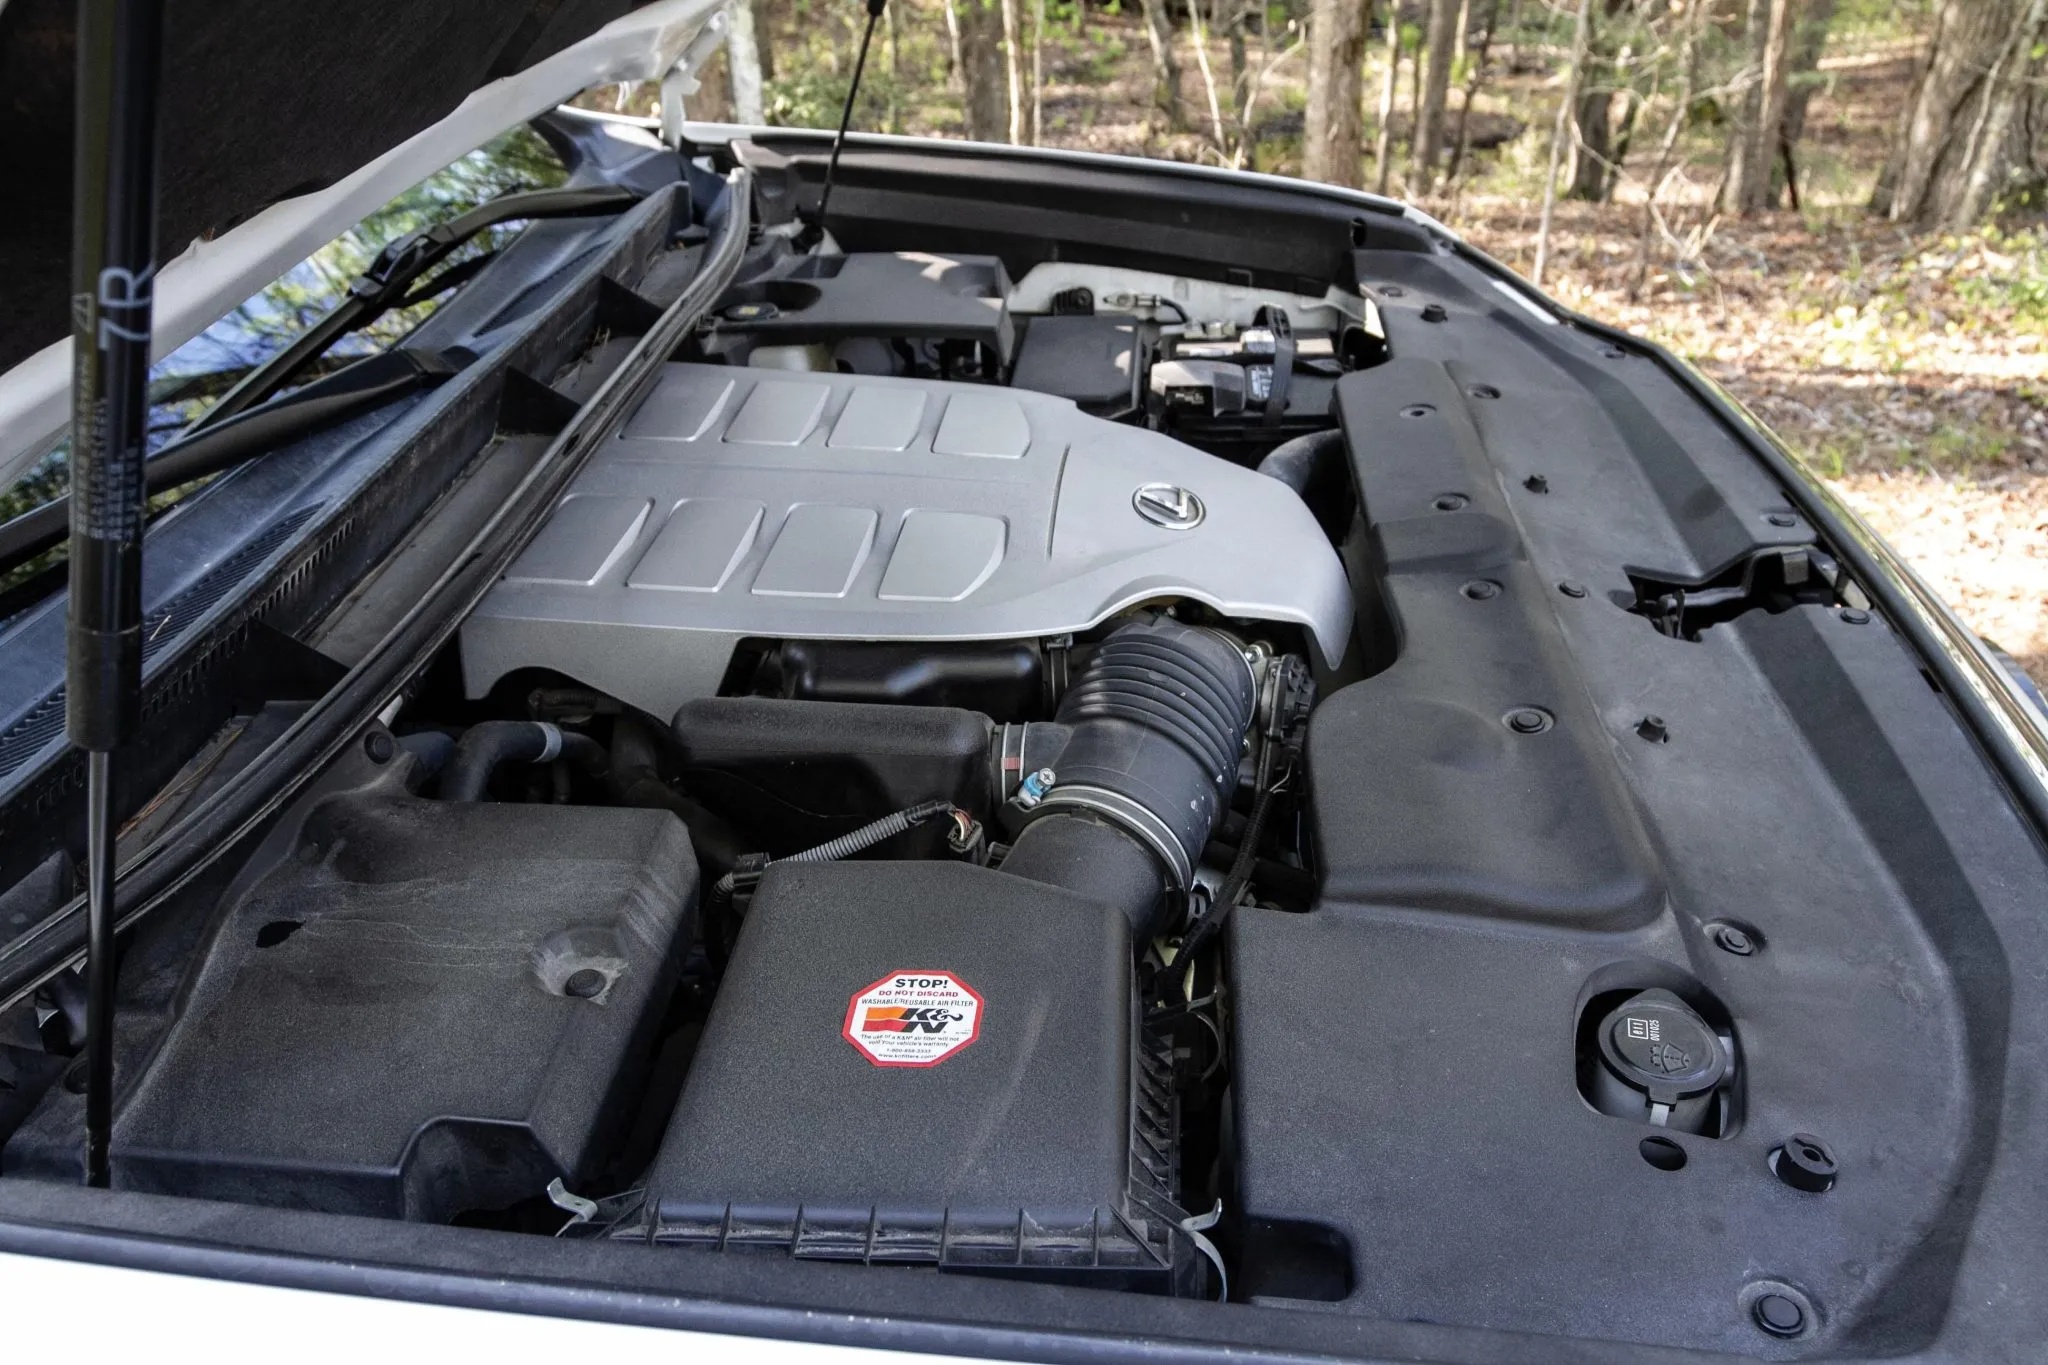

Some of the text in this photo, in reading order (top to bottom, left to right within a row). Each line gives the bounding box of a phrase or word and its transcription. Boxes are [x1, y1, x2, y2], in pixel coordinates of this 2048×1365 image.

[895, 978, 948, 989] STOP!
[917, 990, 959, 998] DISCARD
[861, 998, 935, 1006] WASHABLE/REUSABLE
